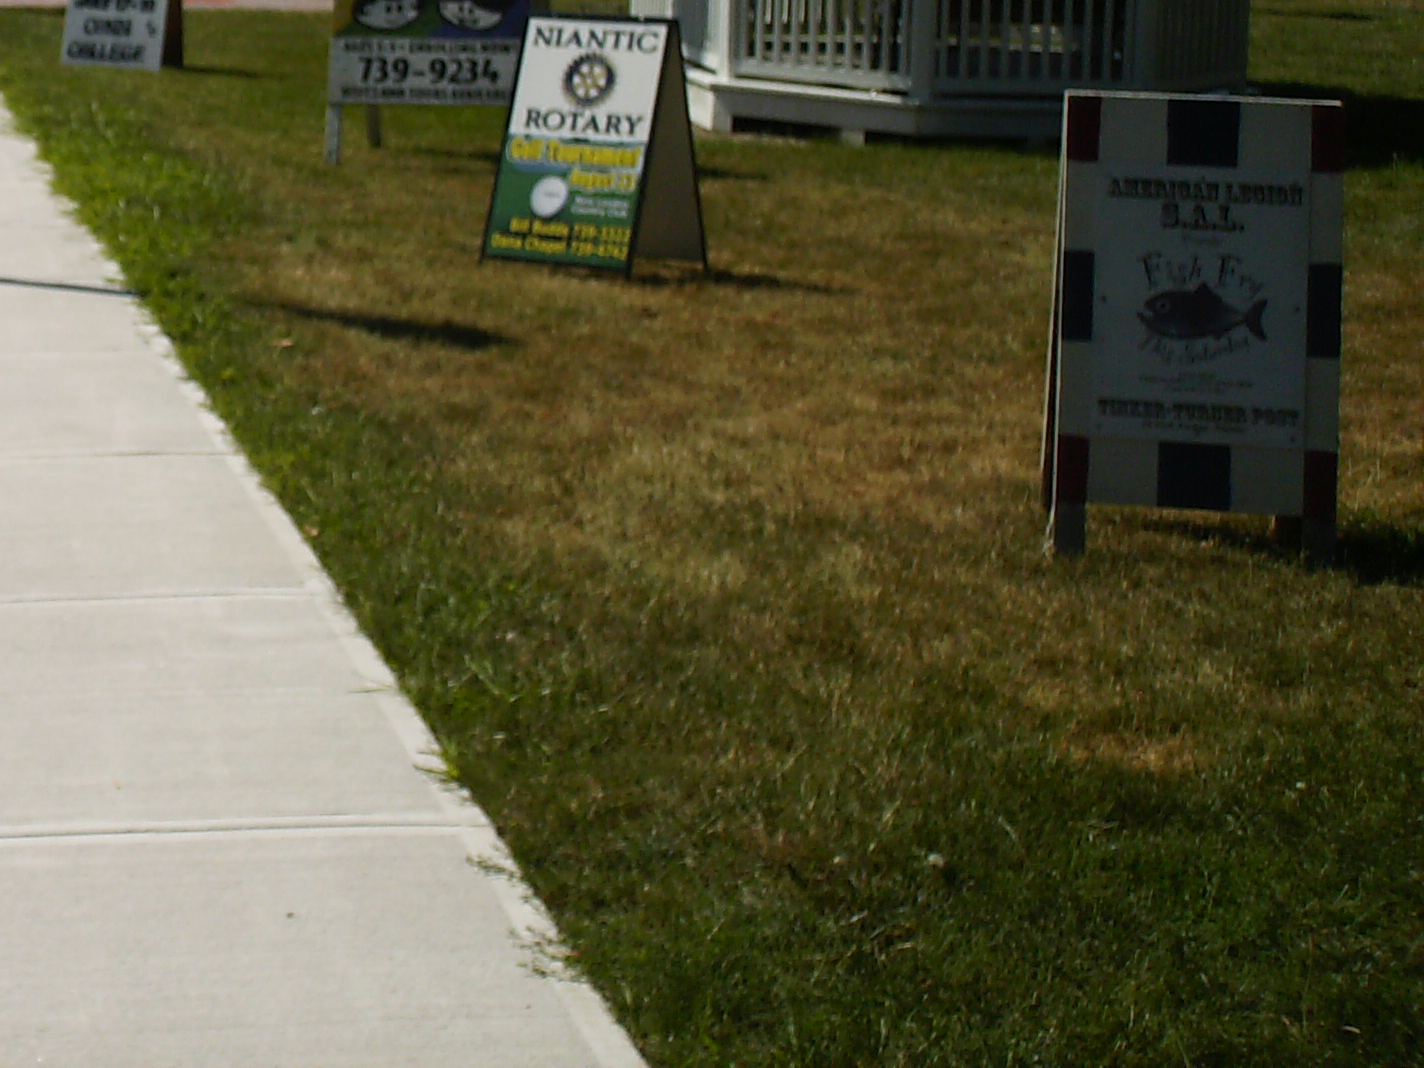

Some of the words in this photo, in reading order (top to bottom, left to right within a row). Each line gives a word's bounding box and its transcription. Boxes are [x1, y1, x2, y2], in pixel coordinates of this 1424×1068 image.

[533, 26, 659, 54] NIANTIC
[358, 55, 500, 85] 739-9234
[524, 108, 646, 137] ROTARY
[510, 137, 544, 161] Golf
[547, 139, 643, 168] Tournament
[1108, 177, 1220, 202] AMERICAN
[1223, 182, 1304, 206] LEGION
[1136, 251, 1202, 290] Fish
[1216, 253, 1264, 300] Fry
